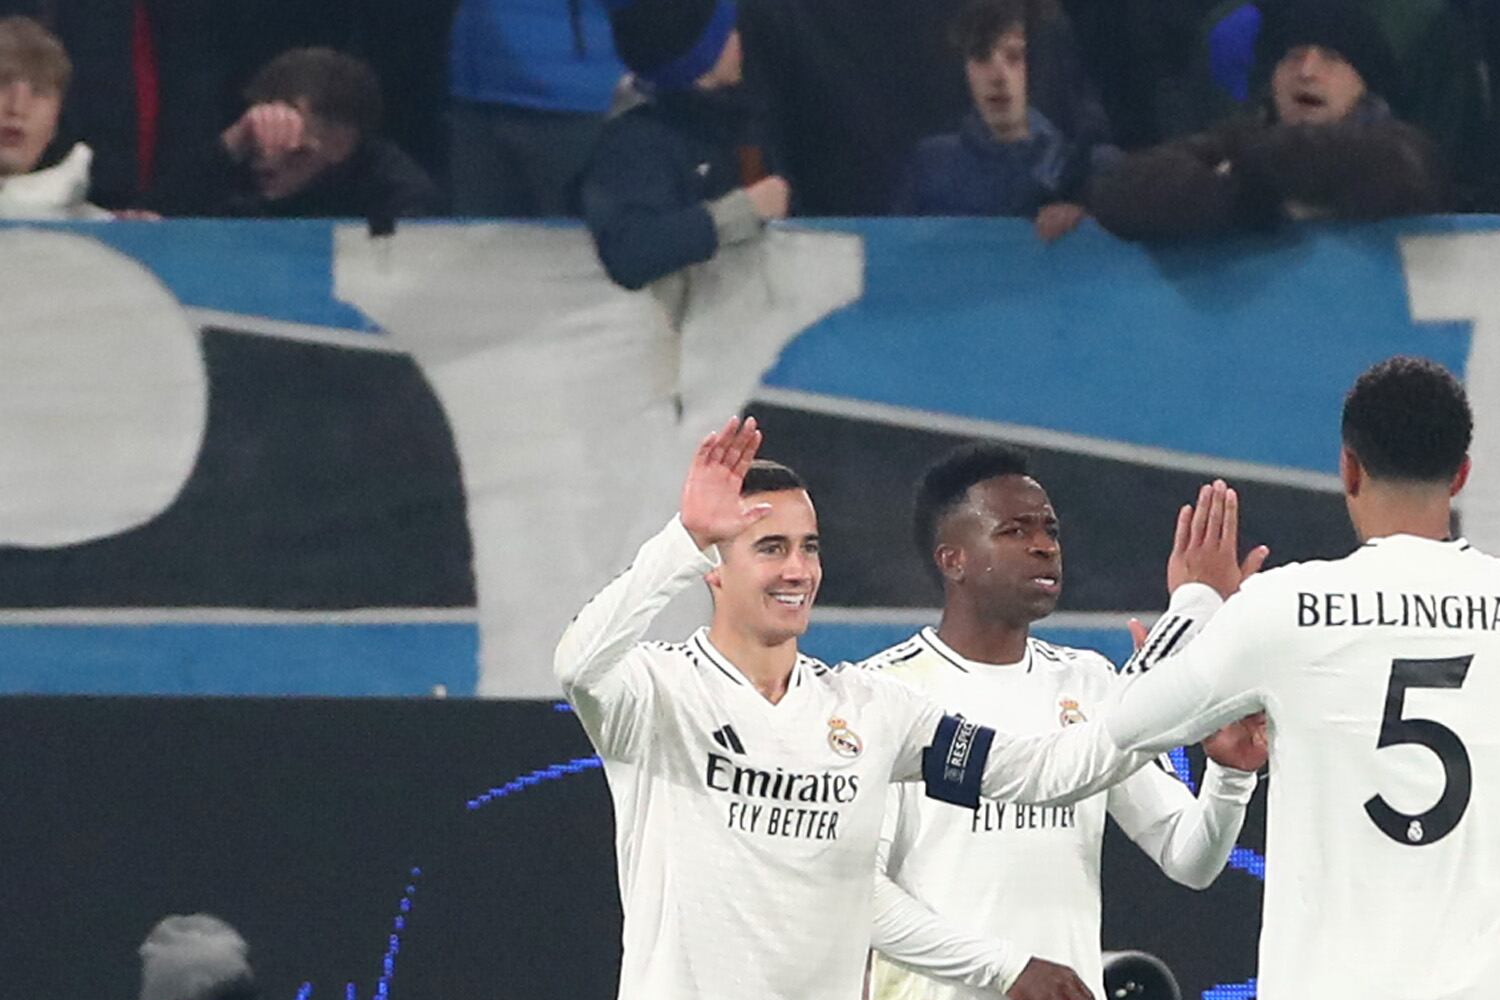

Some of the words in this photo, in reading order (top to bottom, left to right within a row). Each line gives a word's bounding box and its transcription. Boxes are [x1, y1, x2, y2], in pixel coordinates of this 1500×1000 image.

[950, 721, 975, 768] RESPEC
[1363, 654, 1475, 846] 5
[706, 752, 860, 804] Emirates
[728, 802, 762, 833] FLY
[767, 807, 839, 840] BETTER
[972, 800, 1006, 832] FLY
